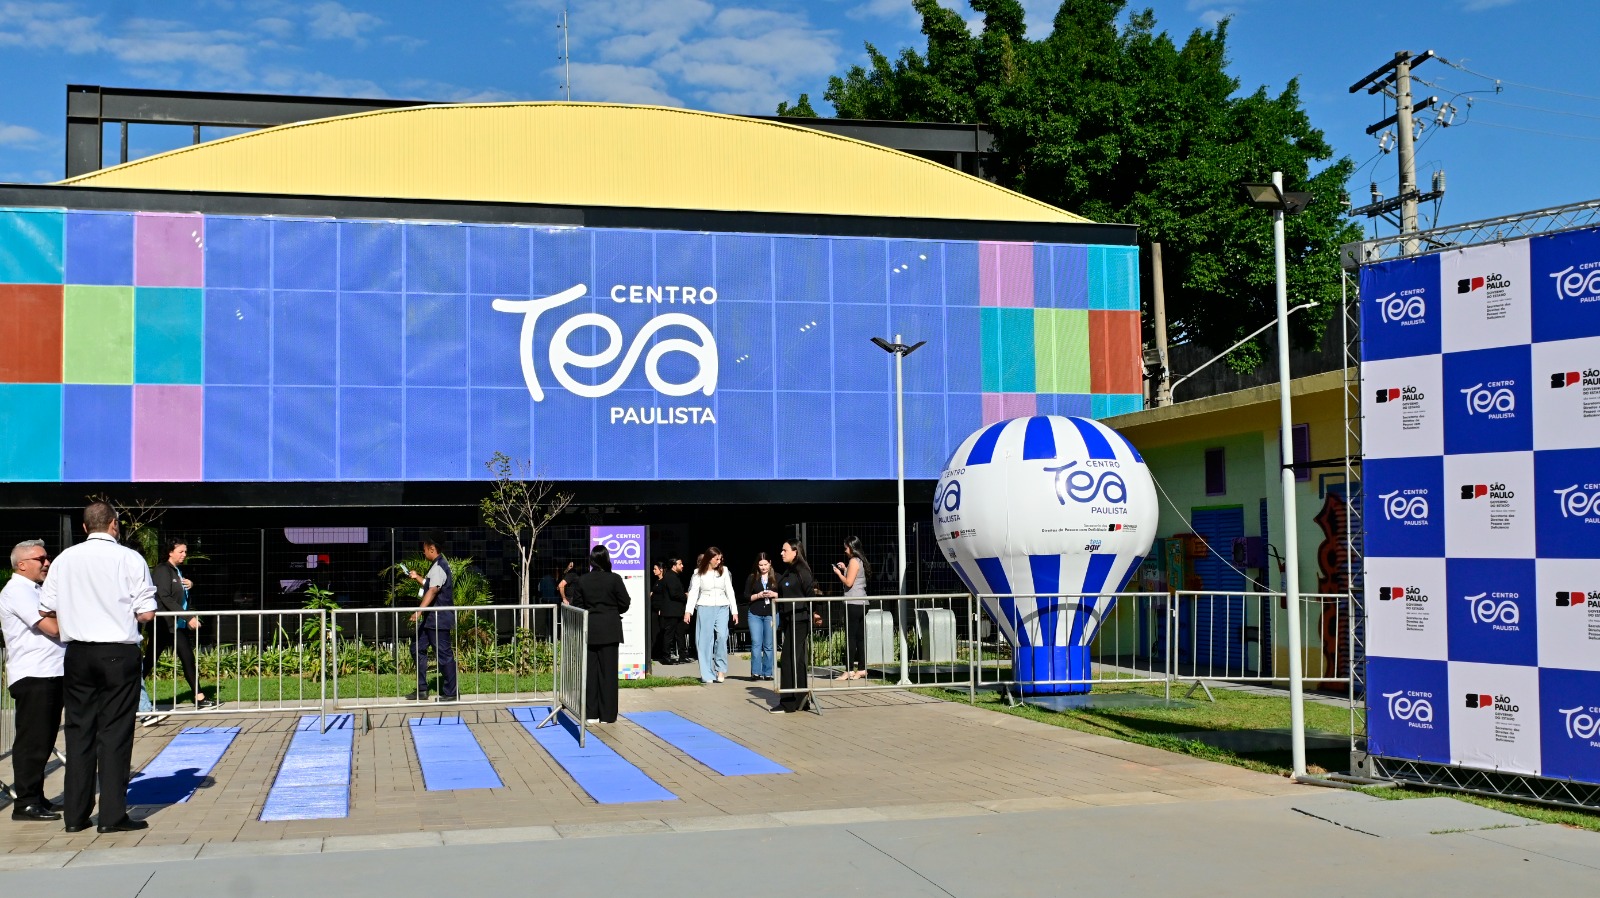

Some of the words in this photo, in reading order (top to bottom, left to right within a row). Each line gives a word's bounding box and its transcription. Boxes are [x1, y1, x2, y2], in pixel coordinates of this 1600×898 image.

[1579, 261, 1600, 270] CENT
[1486, 273, 1502, 282] SÃO
[1486, 280, 1511, 290] PAULO
[611, 285, 717, 304] CENTRO
[1400, 288, 1425, 296] CENTRO
[1402, 385, 1417, 394] SÃO
[1402, 393, 1425, 401] PAULO
[610, 407, 716, 424] PAULISTA
[1086, 460, 1120, 468] CENTRO
[943, 468, 965, 479] CENTRO
[1489, 482, 1506, 491] SÃO
[1489, 491, 1515, 499] PAULO
[1091, 506, 1128, 515] PAULISTA
[1084, 544, 1101, 553] agir
[1405, 586, 1421, 594] SÃO
[1405, 594, 1429, 603] PAULO
[1407, 690, 1432, 698] CENTRO
[1494, 694, 1511, 704] SÃO
[1494, 703, 1520, 713] PAULO
[1558, 705, 1600, 739] Te
